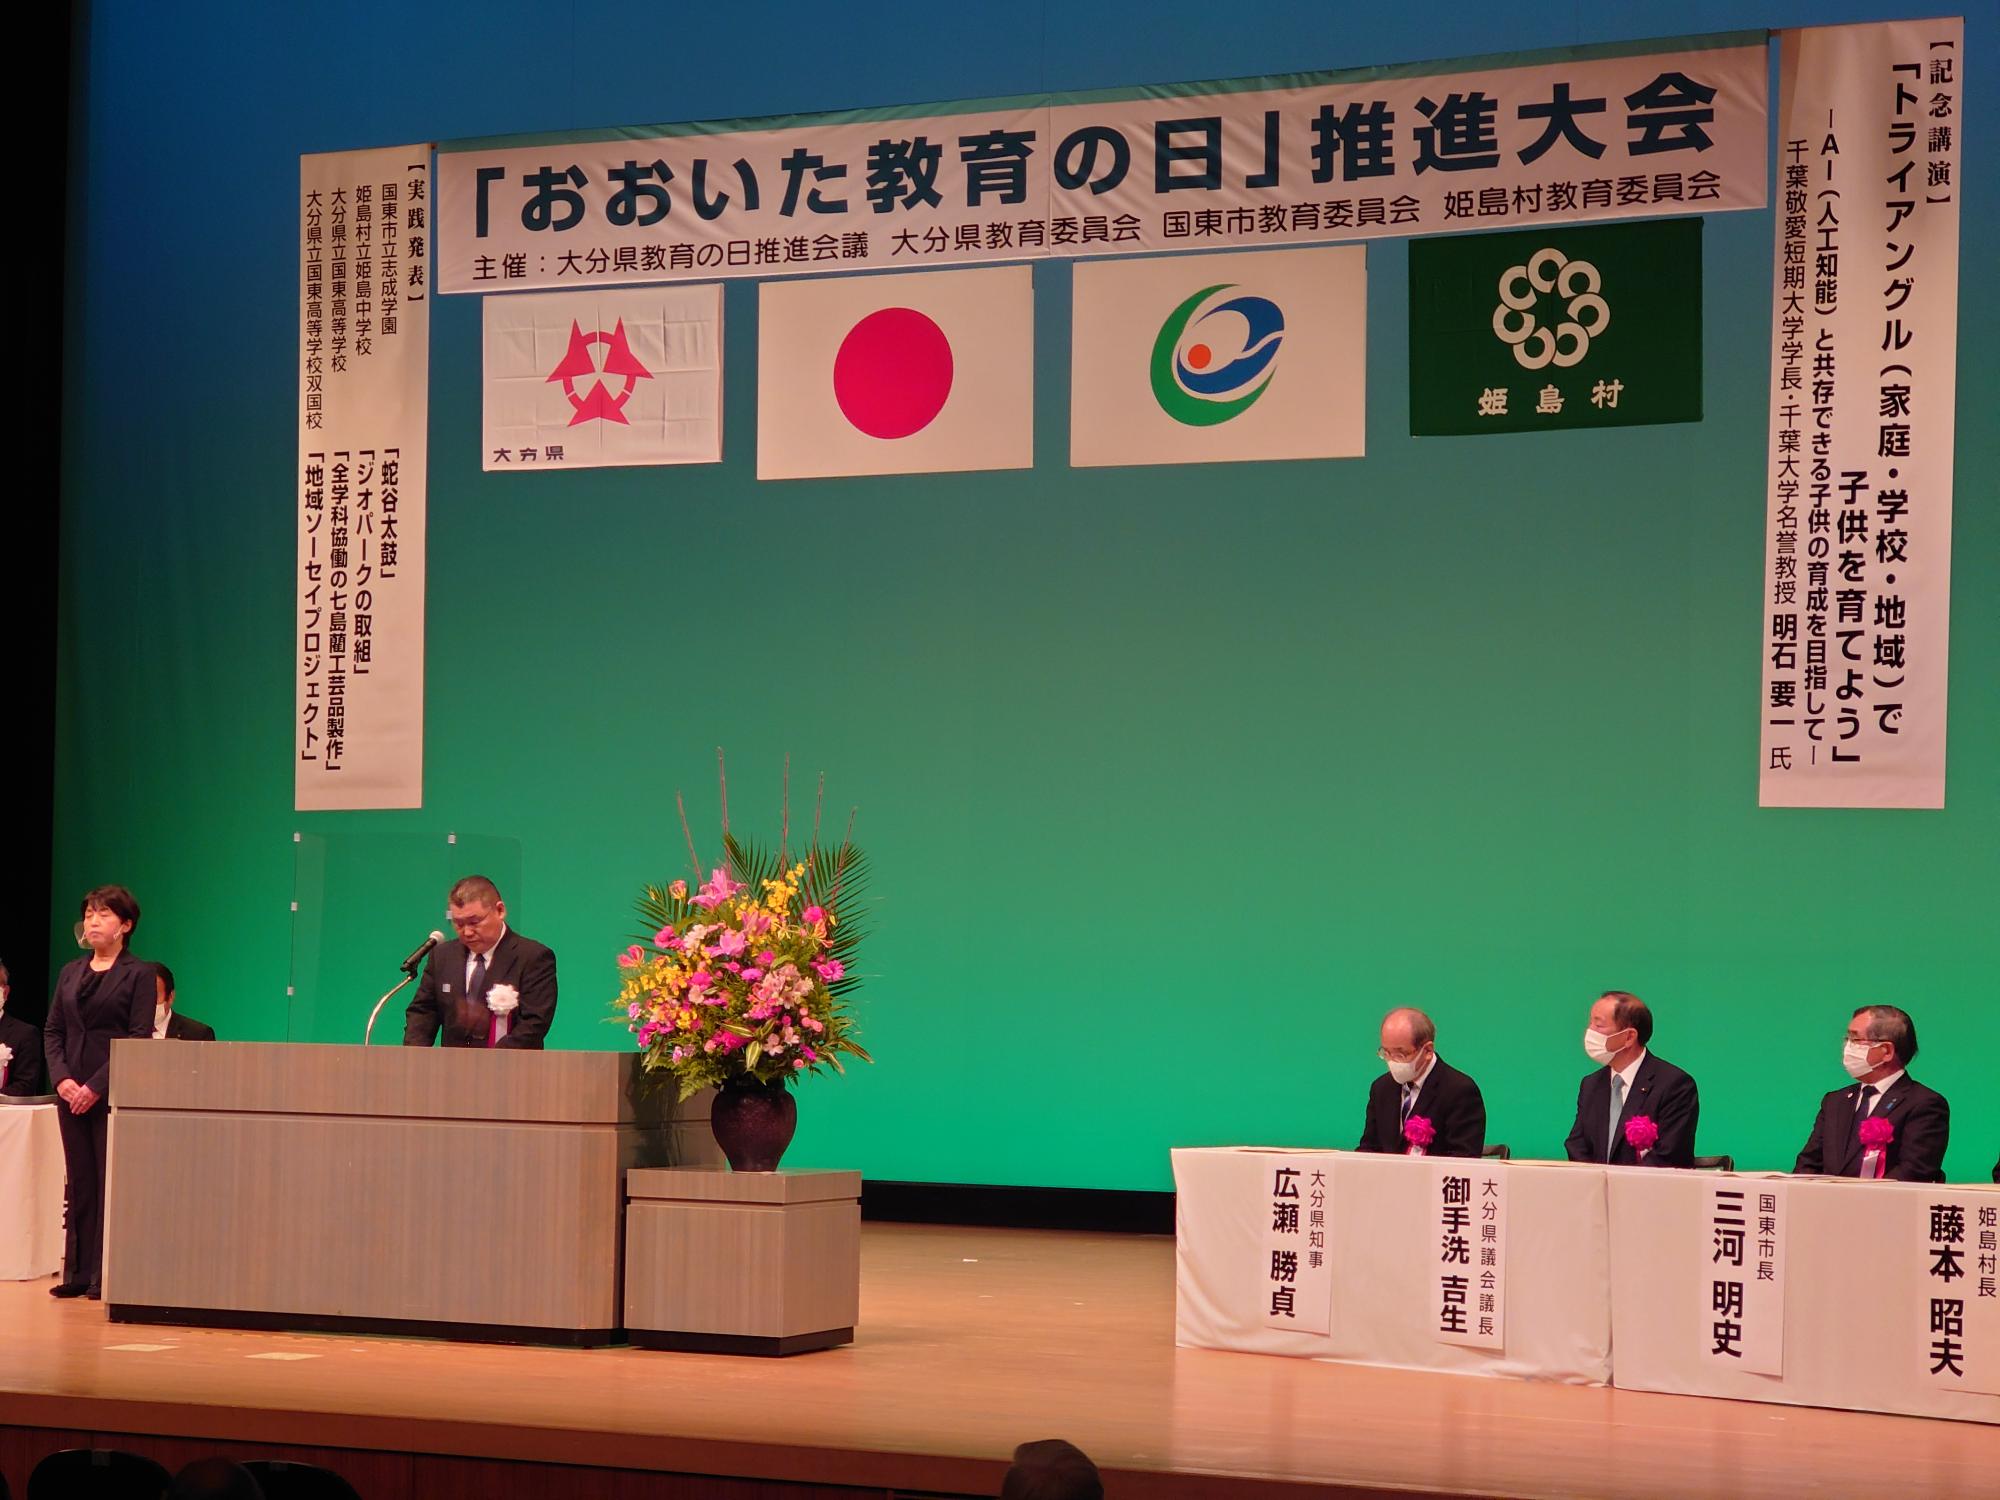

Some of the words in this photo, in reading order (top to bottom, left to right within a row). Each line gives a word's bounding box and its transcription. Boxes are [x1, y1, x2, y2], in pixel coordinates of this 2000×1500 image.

[475, 71, 1718, 238] 「おおいた教育の日」推進大会
[1926, 40, 1954, 203] 【記念講演】
[331, 188, 347, 373] 大分県立国東高等学校
[355, 185, 372, 356] 姫島村立姫島中学校
[381, 183, 398, 335] 国東市立志成学園
[407, 164, 425, 302] 【実践発表】
[472, 231, 869, 280] 主催：大分県教育の日推進会議
[890, 211, 1141, 257] 大分県教育委員会
[1162, 194, 1421, 239] 国東市教育委員会
[1443, 169, 1721, 220] 姫島村教育委員会
[305, 190, 323, 430] 大分県立国東高等学校双国校
[1773, 139, 1809, 605] 千葉敬愛短期大学学長・千葉大学名誉教授
[1478, 378, 1624, 417] 姫島村
[1872, 63, 1921, 735] 「トライアングル（家庭・学校・地域）で
[353, 450, 375, 675] 「ジオパークの取組」
[380, 448, 400, 579] 「蛇谷太鼓」
[301, 452, 324, 761] 「地域ソーセイプロジェクト」
[1832, 470, 1869, 763] 子供を育てよう」
[1272, 1167, 1301, 1235] 広瀬
[1308, 1169, 1326, 1269] 大分県知事
[1441, 1175, 1471, 1265] 御手洗
[1478, 1178, 1498, 1337] 大分県議会議長
[1712, 1190, 1746, 1267] 三河
[1756, 1193, 1776, 1282] 国東市長
[1929, 1203, 1966, 1284] 藤本
[1977, 1205, 1999, 1299] 姫島村長
[1269, 1250, 1298, 1319] 勝貞
[1440, 1274, 1469, 1335] 吉生
[1711, 1280, 1744, 1359] 明史
[1929, 1297, 1965, 1378] 昭夫
